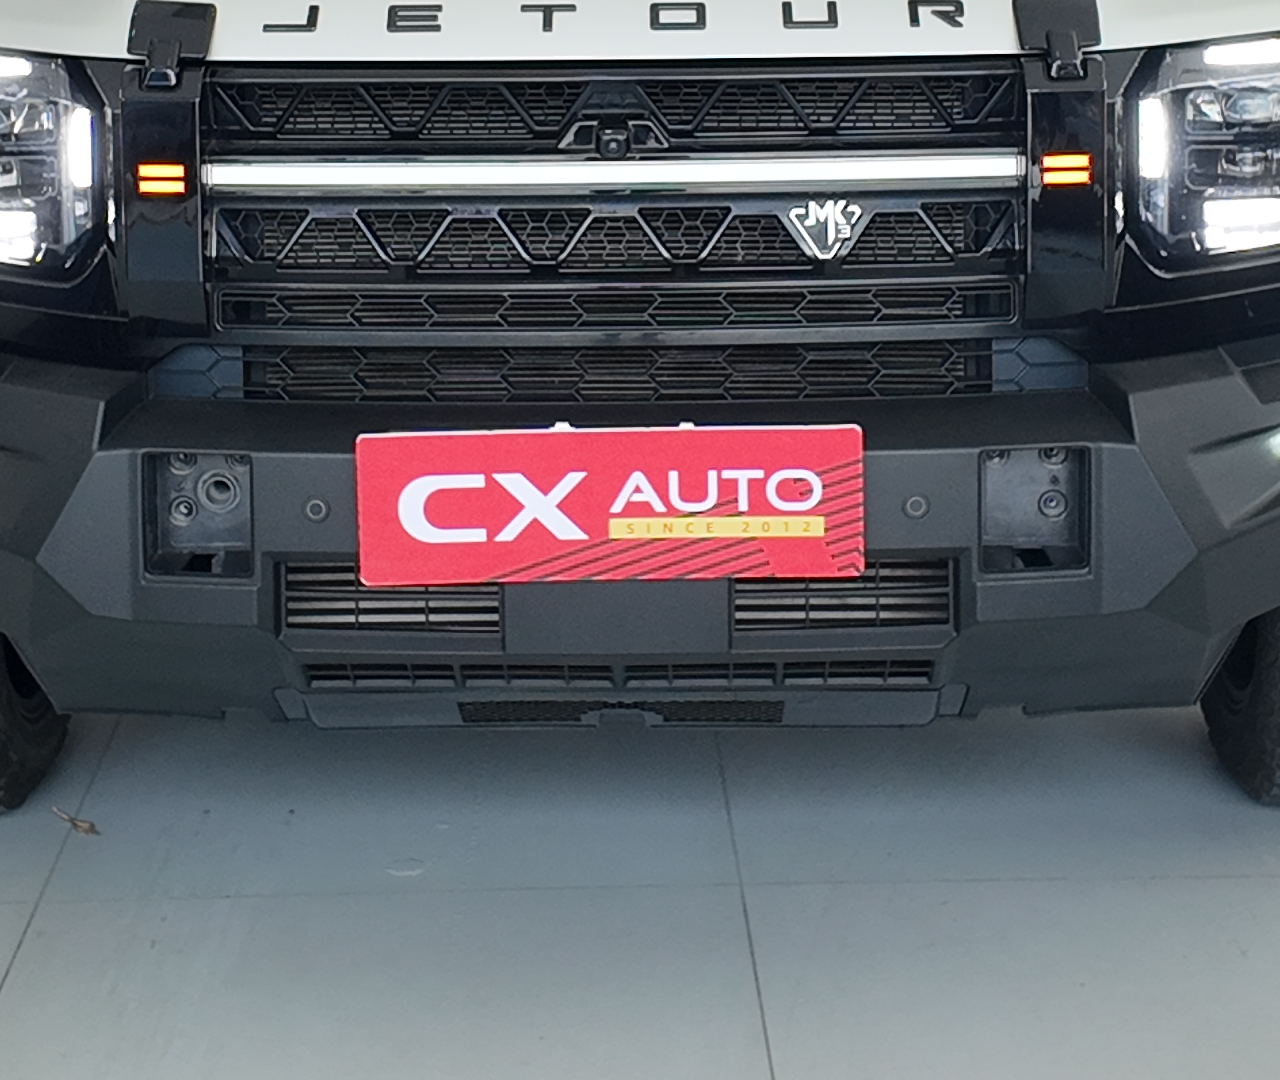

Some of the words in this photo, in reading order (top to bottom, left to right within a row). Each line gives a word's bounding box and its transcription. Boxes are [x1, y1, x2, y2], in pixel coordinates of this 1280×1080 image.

[397, 471, 589, 544] CX
[608, 469, 824, 514] AUTO
[626, 522, 715, 535] SINCE
[740, 520, 812, 534] 2012
